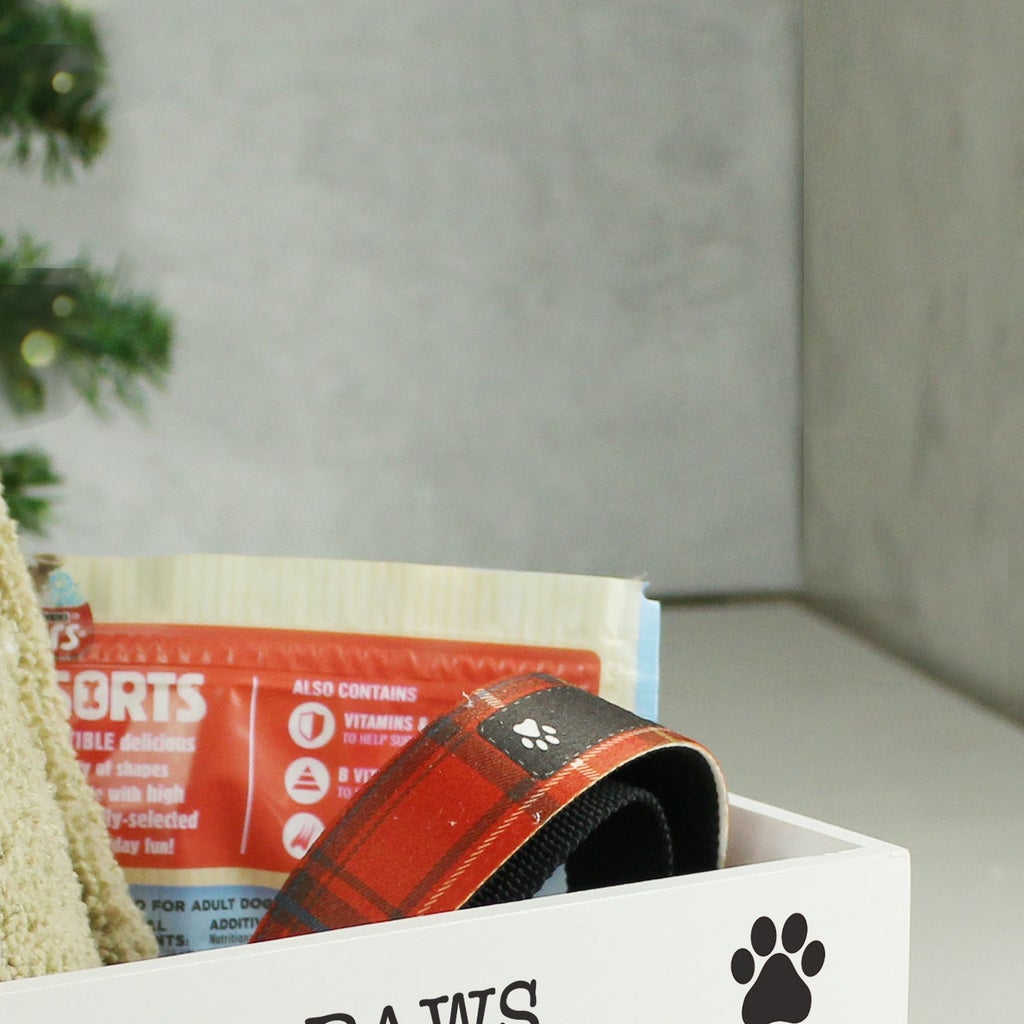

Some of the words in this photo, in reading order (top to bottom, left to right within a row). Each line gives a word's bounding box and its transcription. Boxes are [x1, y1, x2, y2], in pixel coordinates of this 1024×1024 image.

[292, 679, 334, 697] ALSO
[338, 682, 417, 703] CONTAINS
[344, 712, 413, 732] VITAMINS
[120, 732, 196, 753] delicious
[343, 732, 357, 745] TO
[359, 733, 387, 746] HELP
[95, 761, 112, 777] of
[117, 761, 168, 778] shapes
[338, 767, 349, 783] B
[108, 785, 141, 803] with
[145, 784, 185, 805] high
[145, 837, 174, 856] fun!
[152, 900, 185, 913] FOR
[191, 898, 235, 912] ADULT
